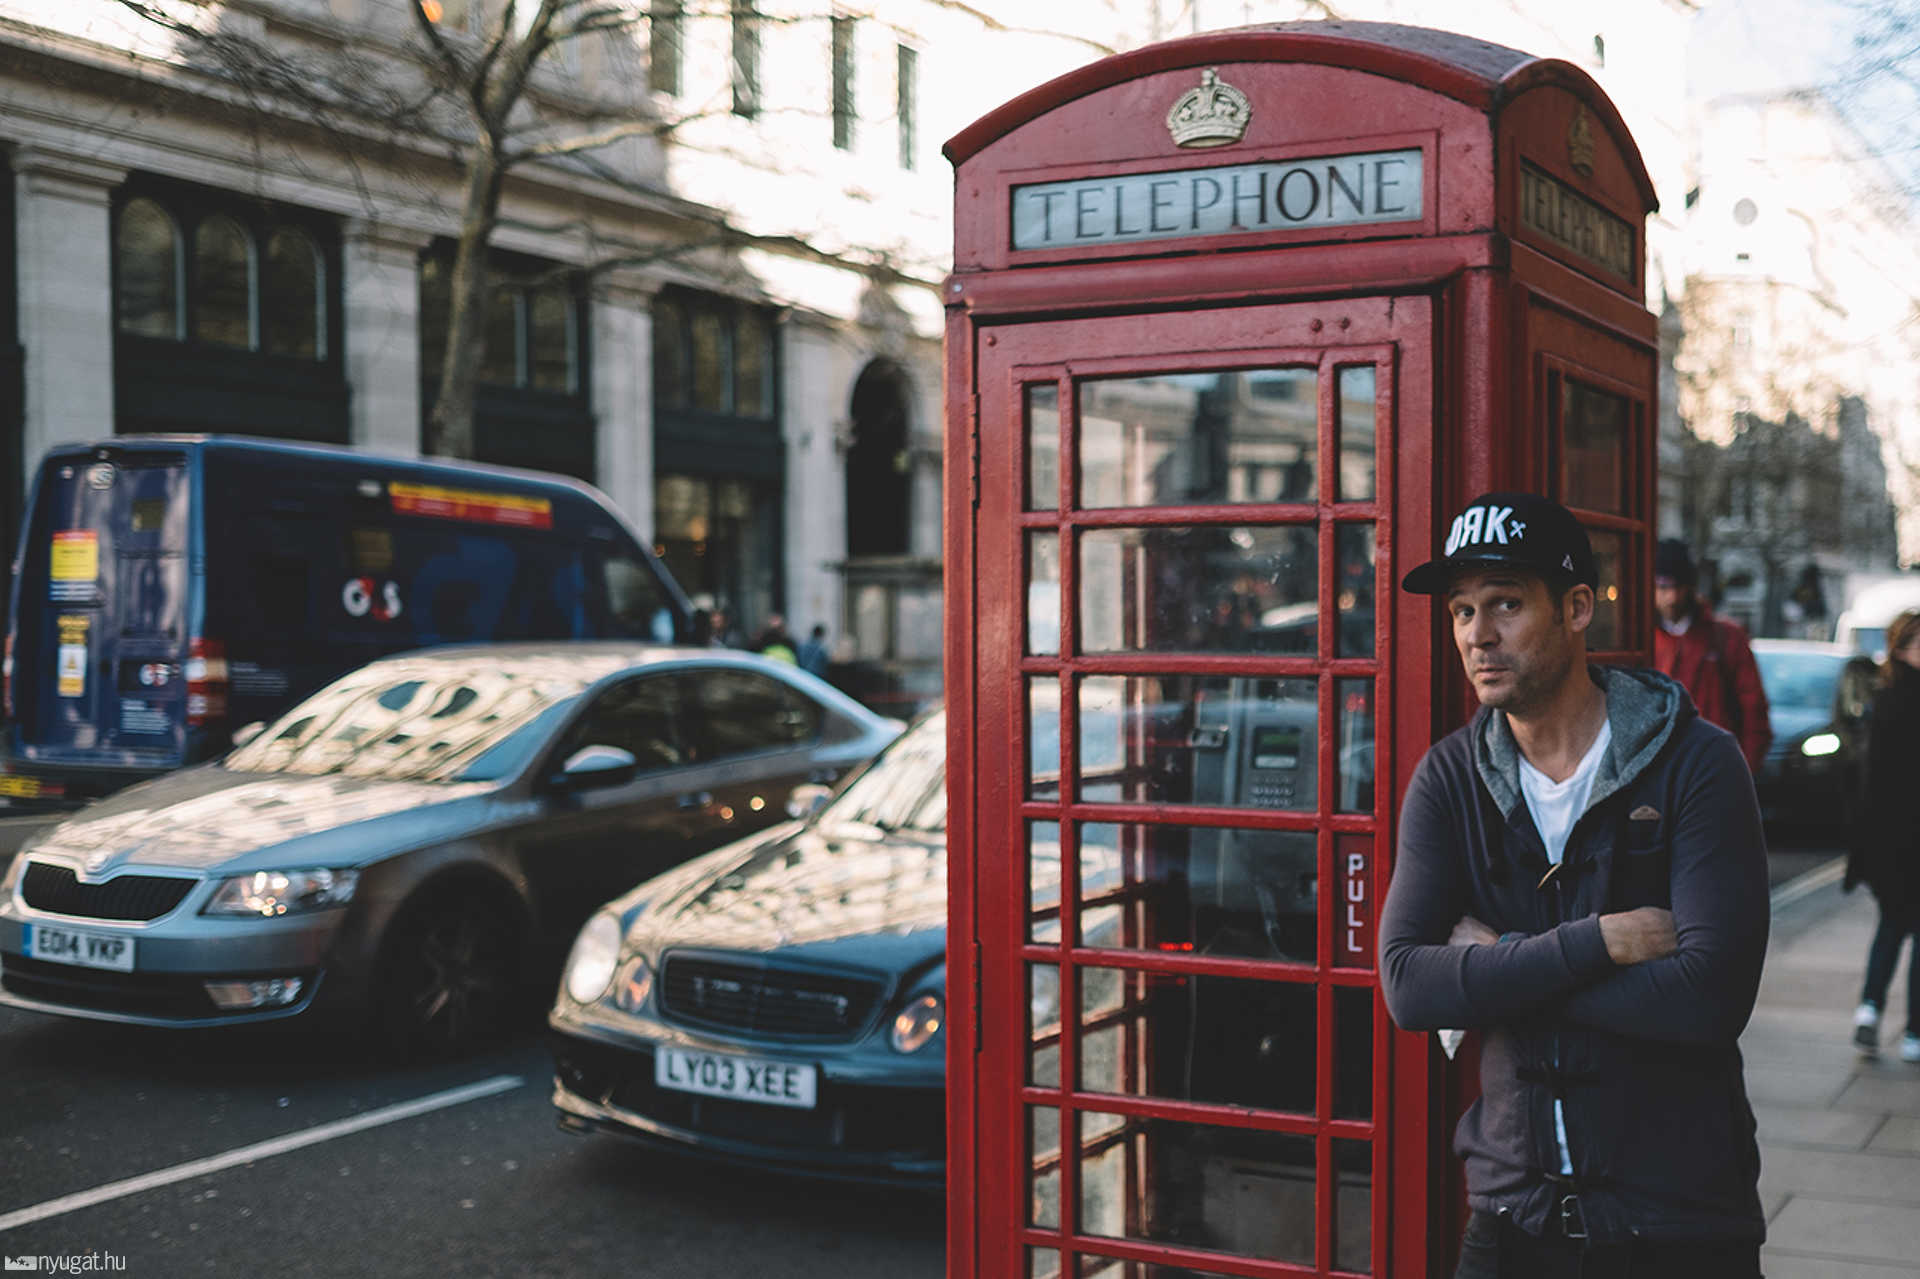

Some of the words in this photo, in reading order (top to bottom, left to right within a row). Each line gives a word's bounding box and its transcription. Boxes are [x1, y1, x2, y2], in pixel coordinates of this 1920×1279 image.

[1030, 159, 1405, 242] TELEPHONE
[1347, 853, 1364, 952] PULL
[666, 1052, 736, 1091] LY03
[744, 1064, 799, 1098] XEE
